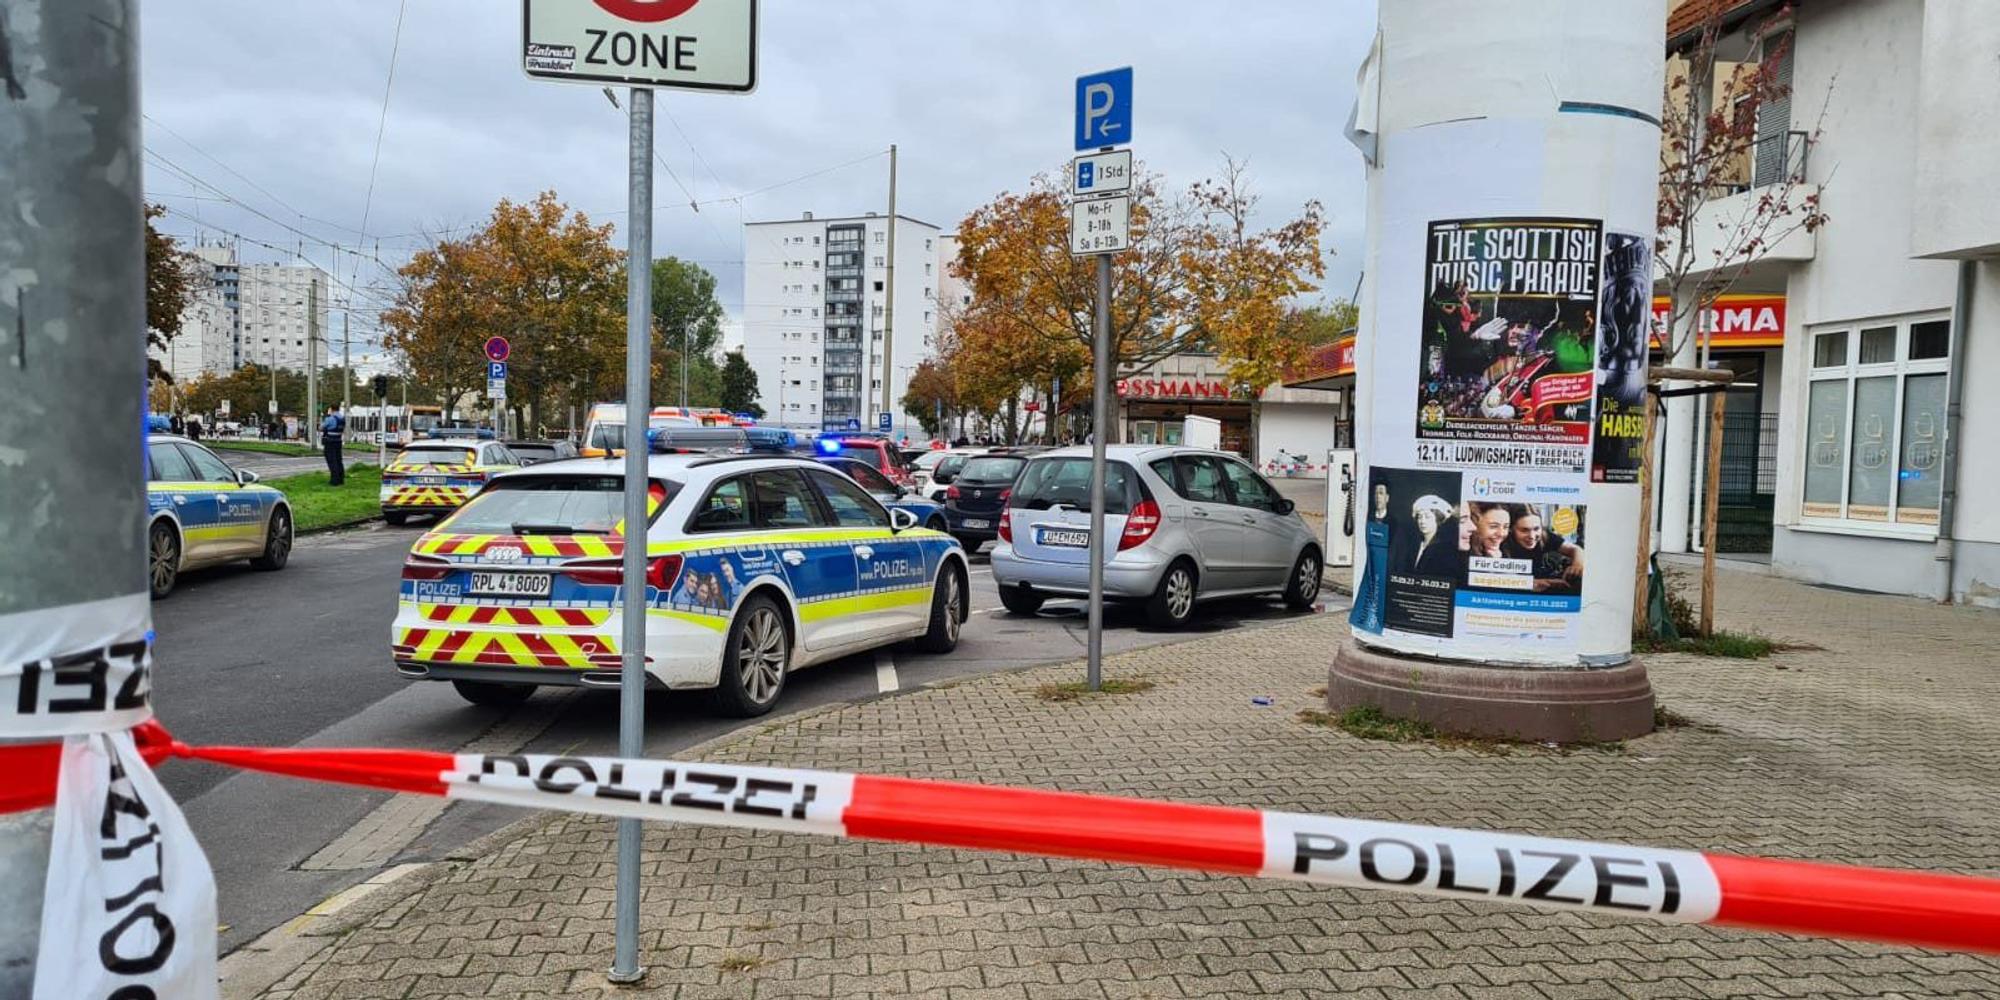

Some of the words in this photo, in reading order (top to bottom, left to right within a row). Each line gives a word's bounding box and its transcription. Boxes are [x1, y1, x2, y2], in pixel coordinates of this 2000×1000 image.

[527, 44, 575, 58] Eintracht
[584, 28, 698, 72] ZONE
[527, 58, 574, 70] Frankfurt
[1084, 82, 1115, 141] P
[1087, 202, 1113, 216] Mo-Fr
[1087, 219, 1112, 233] 8-18h
[1080, 238, 1090, 250] Sa
[1094, 235, 1119, 249] 8-13h
[1433, 229, 1478, 262] THE
[1483, 228, 1597, 261] SCOTTISH
[1430, 261, 1503, 297] MUSIC
[1509, 261, 1595, 295] PARADE
[1602, 397, 1619, 412] Die
[1416, 445, 1449, 461] 12.11.
[1455, 446, 1533, 465] LUDWIGSHAFEN
[1492, 486, 1515, 494] CODE
[1474, 559, 1491, 569] Für
[1492, 560, 1527, 571] Coding
[418, 582, 462, 597] POLIZEI
[470, 572, 495, 591] RPL
[498, 576, 507, 590] 4
[516, 576, 549, 594] 8009
[1292, 831, 1681, 915] POLIZEI
